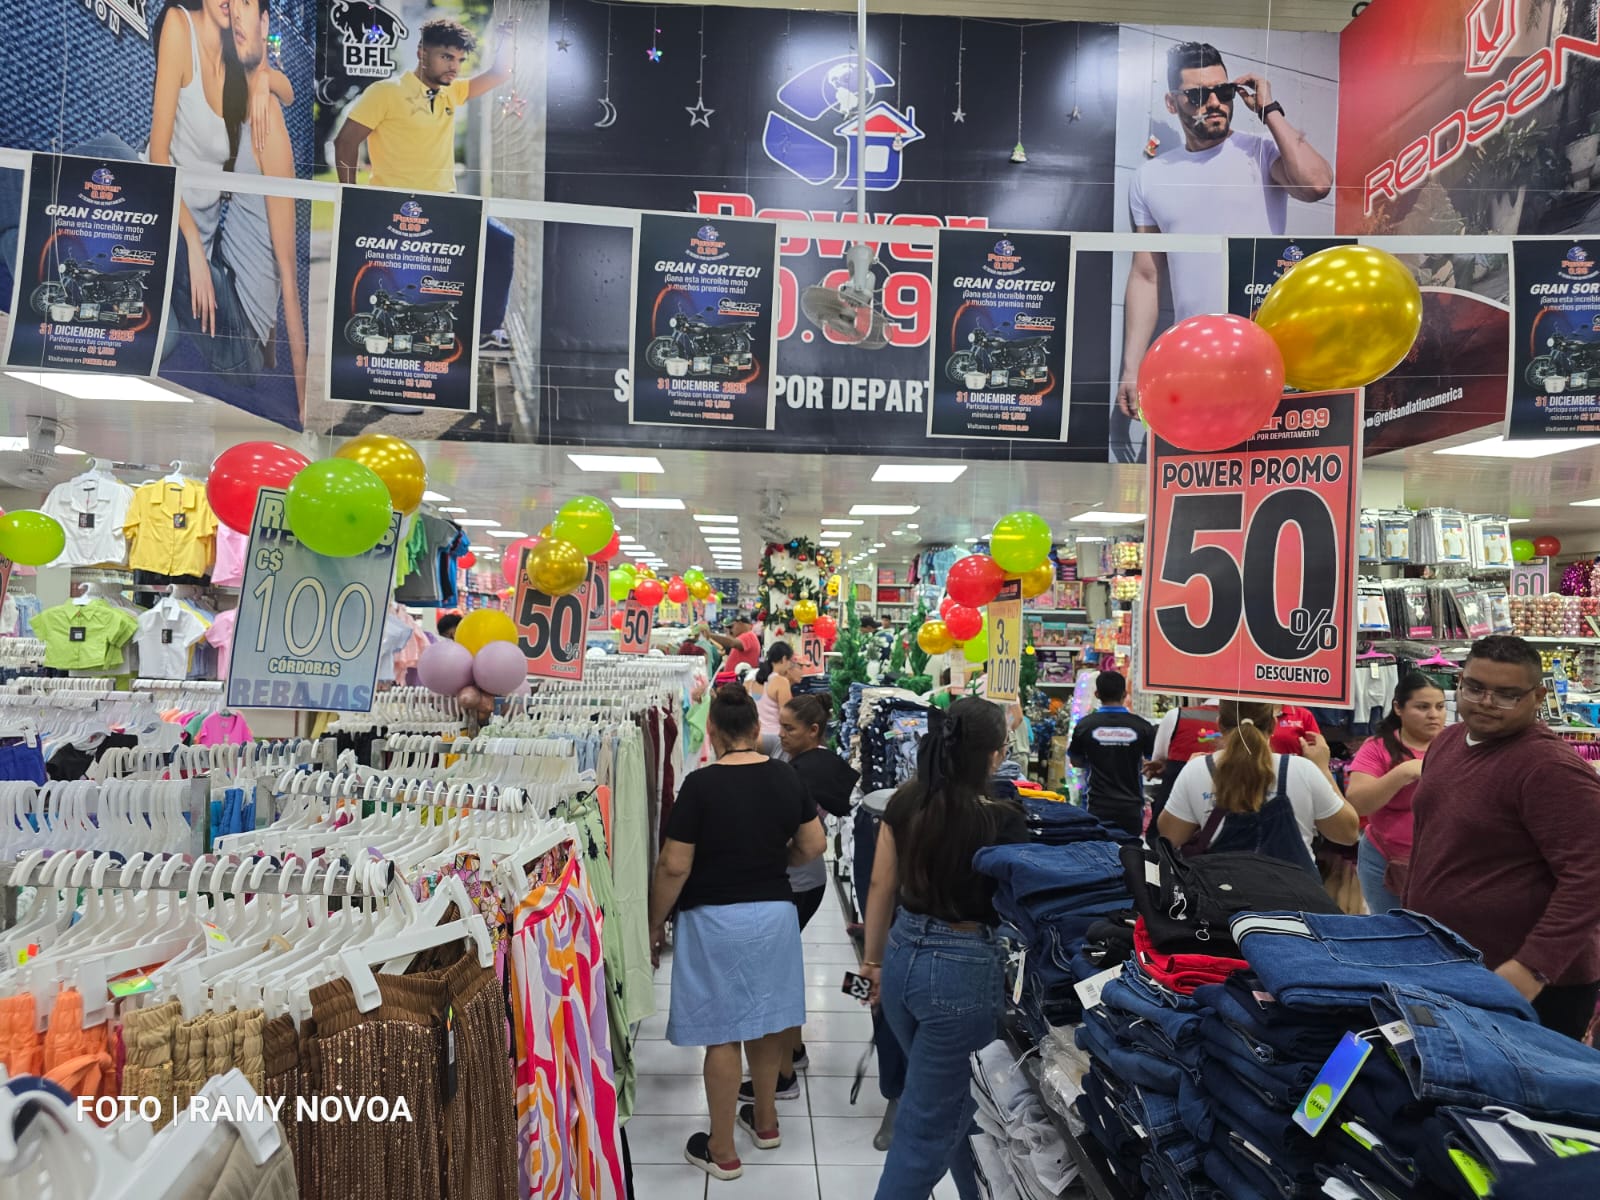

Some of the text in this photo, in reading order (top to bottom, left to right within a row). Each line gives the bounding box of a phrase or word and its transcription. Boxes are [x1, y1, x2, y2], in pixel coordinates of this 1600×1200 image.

[345, 45, 394, 67] BFL
[348, 67, 389, 76] BY BUFFALO
[45, 204, 158, 225] GRAN SORTEO!
[76, 220, 92, 229] esta
[126, 225, 144, 234] moto
[694, 190, 989, 262] owe
[64, 228, 92, 238] muchos
[93, 231, 122, 241] premios
[123, 232, 142, 242] más!
[355, 236, 465, 257] GRAN SORTEO!
[374, 259, 402, 269] muchos
[403, 262, 431, 272] premios
[432, 264, 449, 273] más!
[386, 252, 401, 260] esta
[434, 257, 451, 265] moto
[654, 260, 761, 279] GRAN SORTEO!
[684, 275, 699, 283] esta
[730, 279, 748, 287] moto
[953, 276, 1056, 292] GRAN SORTEO!
[673, 283, 699, 292] muchos
[701, 285, 728, 294] premios
[729, 286, 746, 295] más!
[982, 291, 997, 299] esta
[1244, 283, 1272, 295] GRA
[1530, 283, 1600, 295] GRAN SOR
[971, 299, 997, 307] muchos
[998, 299, 1024, 308] premios
[1025, 300, 1042, 309] más!
[39, 322, 52, 335] 31
[54, 324, 106, 339] DICIEMBRE
[49, 335, 74, 345] Participa
[356, 355, 369, 368] 31
[371, 356, 421, 371] DICIEMBRE
[367, 367, 391, 377] Participa
[614, 368, 630, 402] S
[775, 377, 824, 409] POR
[657, 377, 670, 390] 31
[672, 379, 720, 392] DICIEMBRE
[667, 390, 691, 399] Participa
[956, 391, 969, 403] 31
[970, 392, 1017, 405] DICIEMBRE
[1535, 395, 1597, 407] 31 DICIEMBRE
[966, 403, 989, 412] Participa
[1373, 387, 1463, 427] @redsandlatinoamerica
[1257, 432, 1269, 441] POR
[1270, 429, 1320, 440] DEPARTAMENTO
[1162, 454, 1343, 489] POWER PROMO
[256, 548, 284, 573] C$
[1514, 572, 1544, 597] 60
[253, 575, 374, 661] 100
[268, 656, 340, 677] CÓRDOBAS
[1256, 665, 1330, 684] DESCUENTO
[231, 678, 371, 709] REBAJAS
[852, 976, 870, 999] 23
